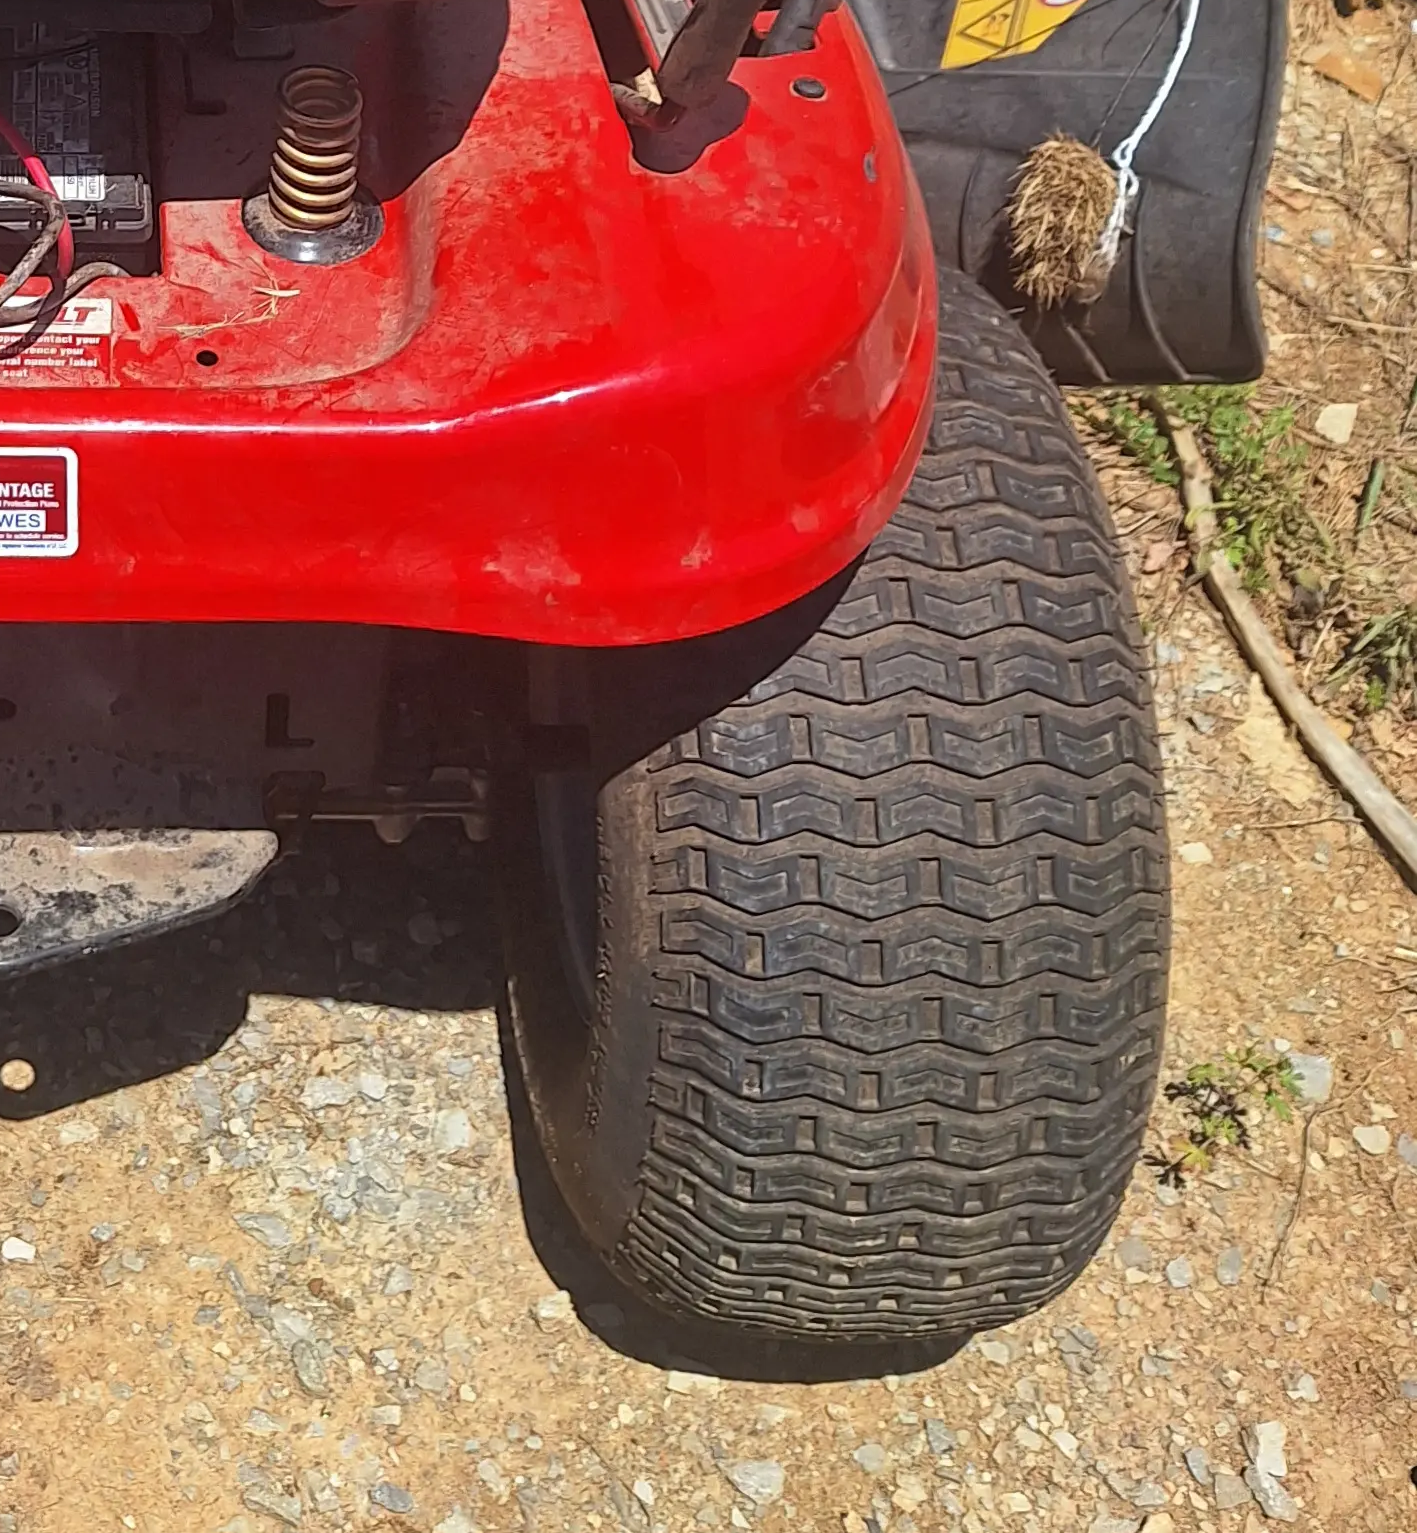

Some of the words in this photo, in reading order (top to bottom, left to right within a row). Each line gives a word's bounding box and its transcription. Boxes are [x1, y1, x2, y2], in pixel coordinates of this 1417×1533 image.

[30, 334, 72, 343] contact
[76, 336, 100, 345] your
[60, 347, 84, 356] your
[24, 357, 66, 366] number
[69, 357, 98, 367] label
[2, 368, 29, 377] seat
[3, 500, 38, 508] Protection
